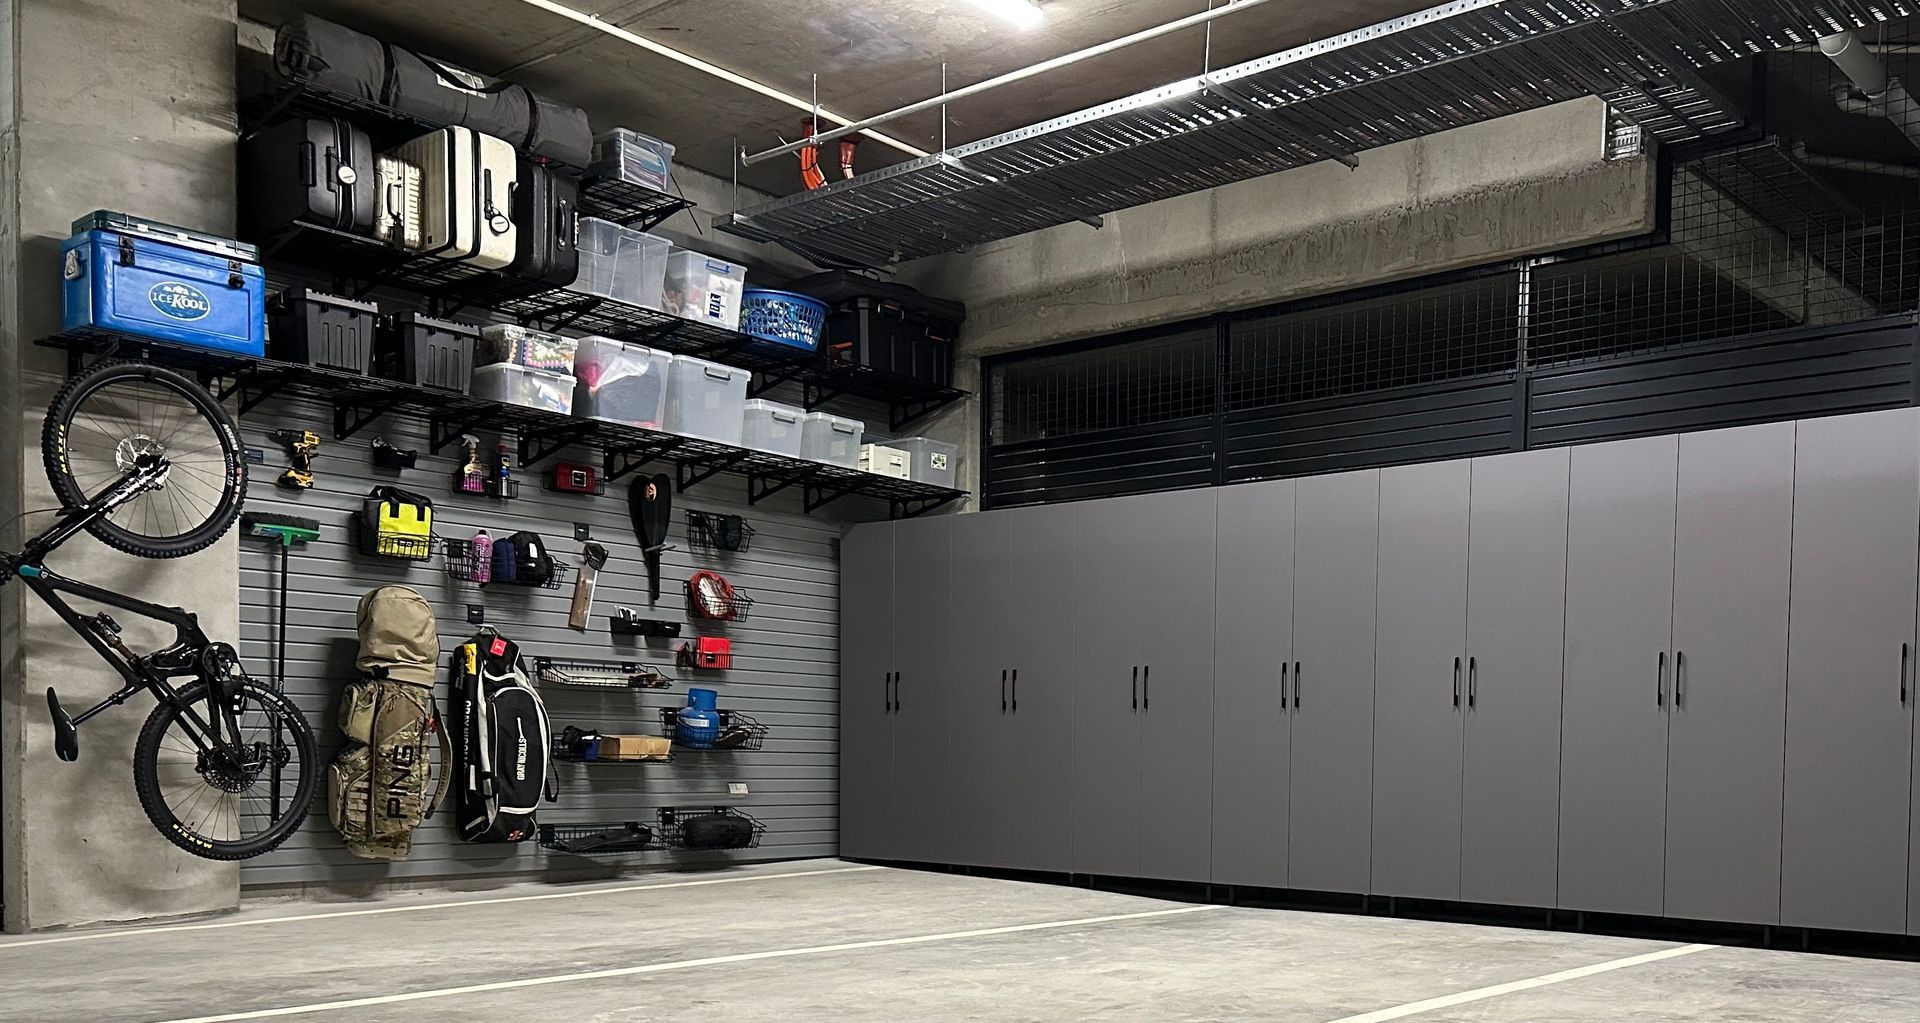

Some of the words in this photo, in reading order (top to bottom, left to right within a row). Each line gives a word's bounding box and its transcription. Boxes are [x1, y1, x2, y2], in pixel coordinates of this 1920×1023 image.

[58, 424, 68, 474] MAXXIS
[386, 744, 414, 818] PING
[172, 823, 213, 849] MAXXIS
